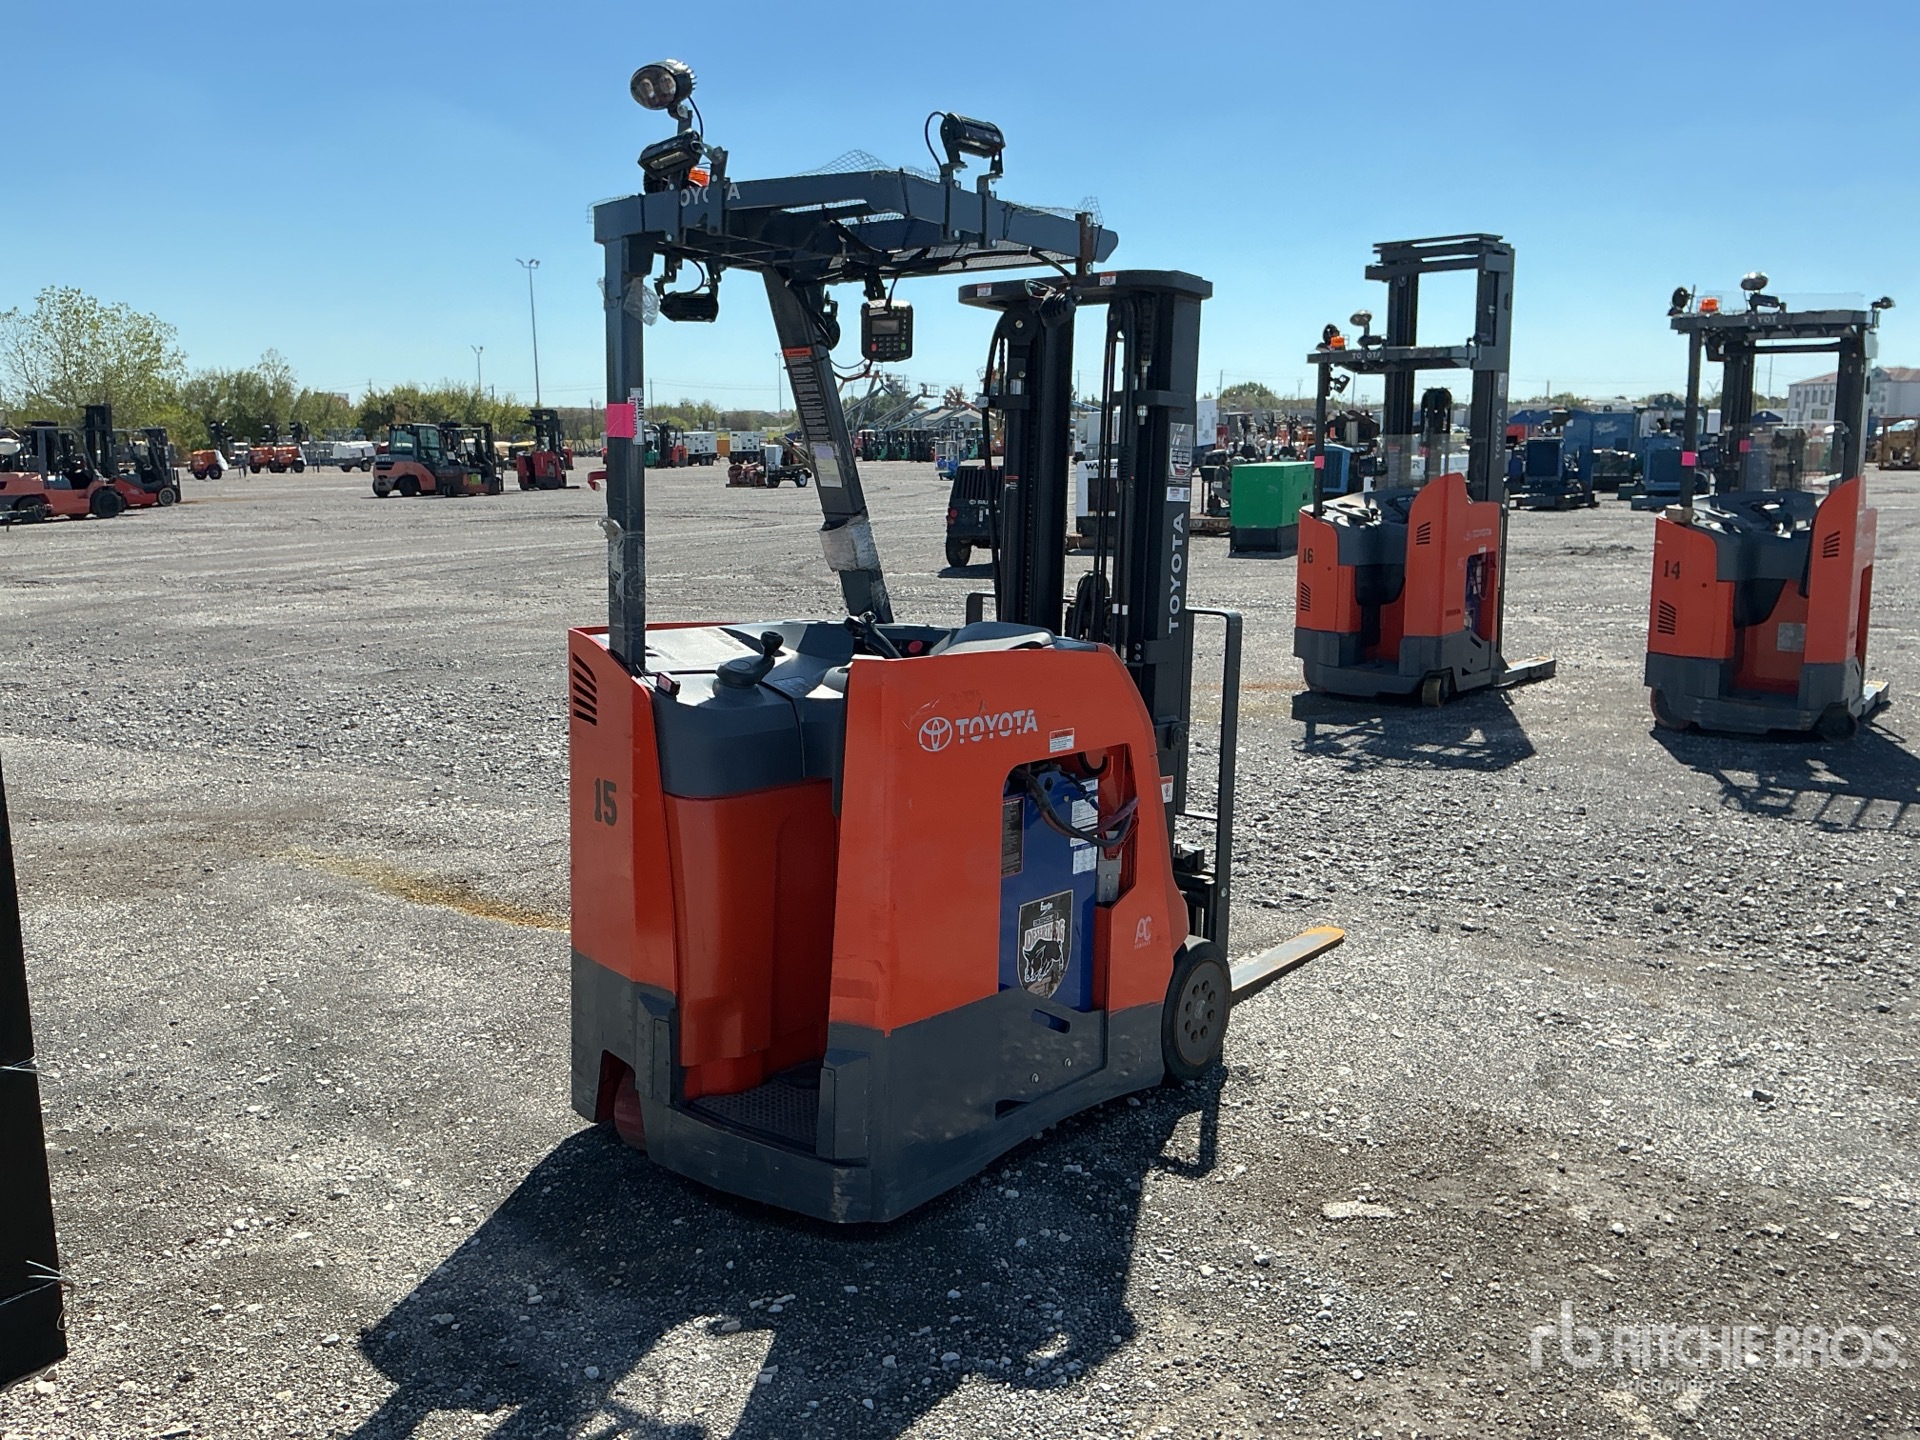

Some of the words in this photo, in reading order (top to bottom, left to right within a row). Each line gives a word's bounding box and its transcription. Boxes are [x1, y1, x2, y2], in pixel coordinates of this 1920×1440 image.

[680, 184, 741, 208] OYOA
[1495, 408, 1503, 460] TOYOTA
[1168, 512, 1185, 635] TOYOTA
[1302, 547, 1314, 565] 16
[1663, 559, 1681, 580] 14
[955, 709, 1039, 744] TOYOTA
[594, 777, 618, 827] 15
